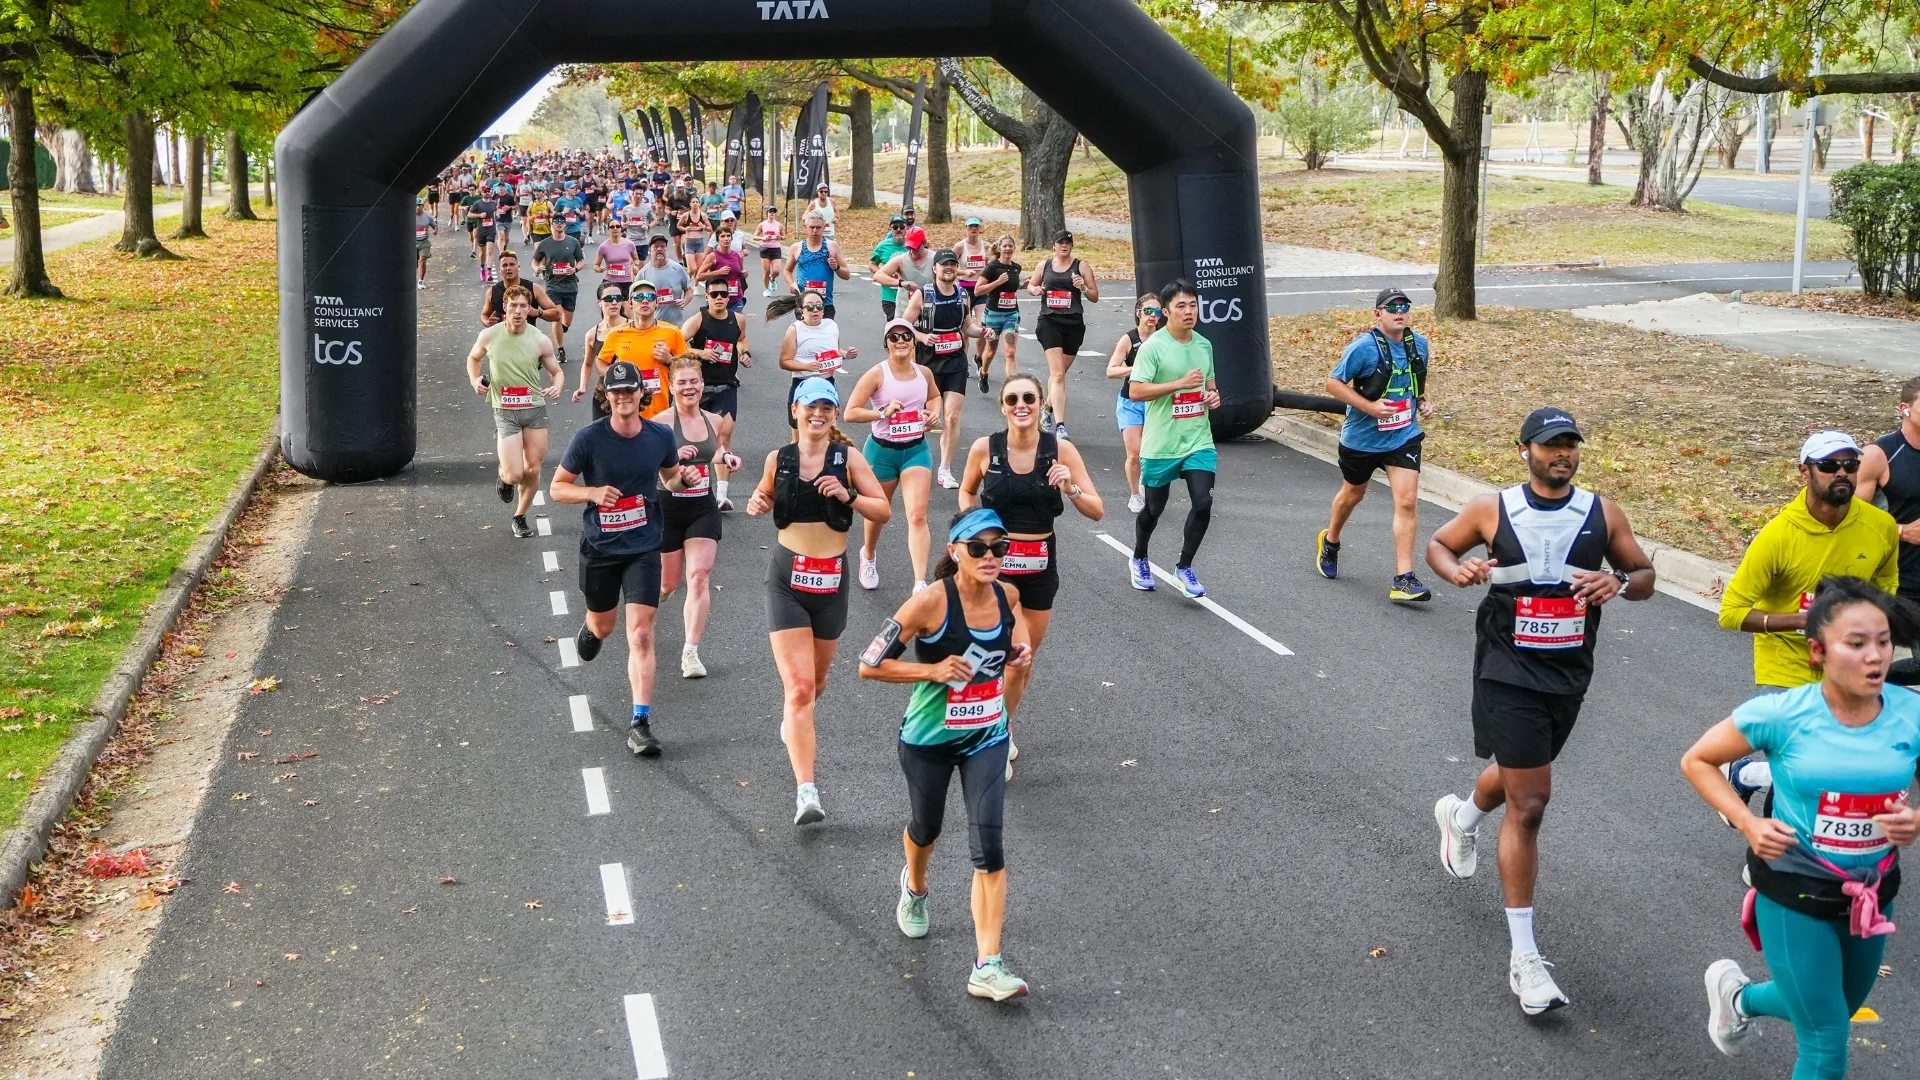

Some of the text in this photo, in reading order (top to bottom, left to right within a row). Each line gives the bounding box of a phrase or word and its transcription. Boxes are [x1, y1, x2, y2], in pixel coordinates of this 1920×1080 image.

[757, 1, 829, 20] TATA
[1195, 258, 1224, 267] TATA
[1196, 265, 1255, 278] CONSULTANCY
[1196, 277, 1239, 289] SERVICES
[314, 295, 344, 305] TATA
[314, 306, 384, 317] CONSULTANCY
[1199, 294, 1243, 324] tcs
[314, 317, 359, 328] SERVICES
[314, 333, 363, 365] tcs
[503, 395, 521, 403] 9613
[1174, 405, 1194, 414] 8137
[891, 425, 911, 434] 8451
[602, 514, 627, 523] 7221
[794, 574, 823, 586] 8818
[1519, 620, 1560, 635] 7857
[950, 705, 985, 717] 6949
[1821, 819, 1874, 838] 7838
